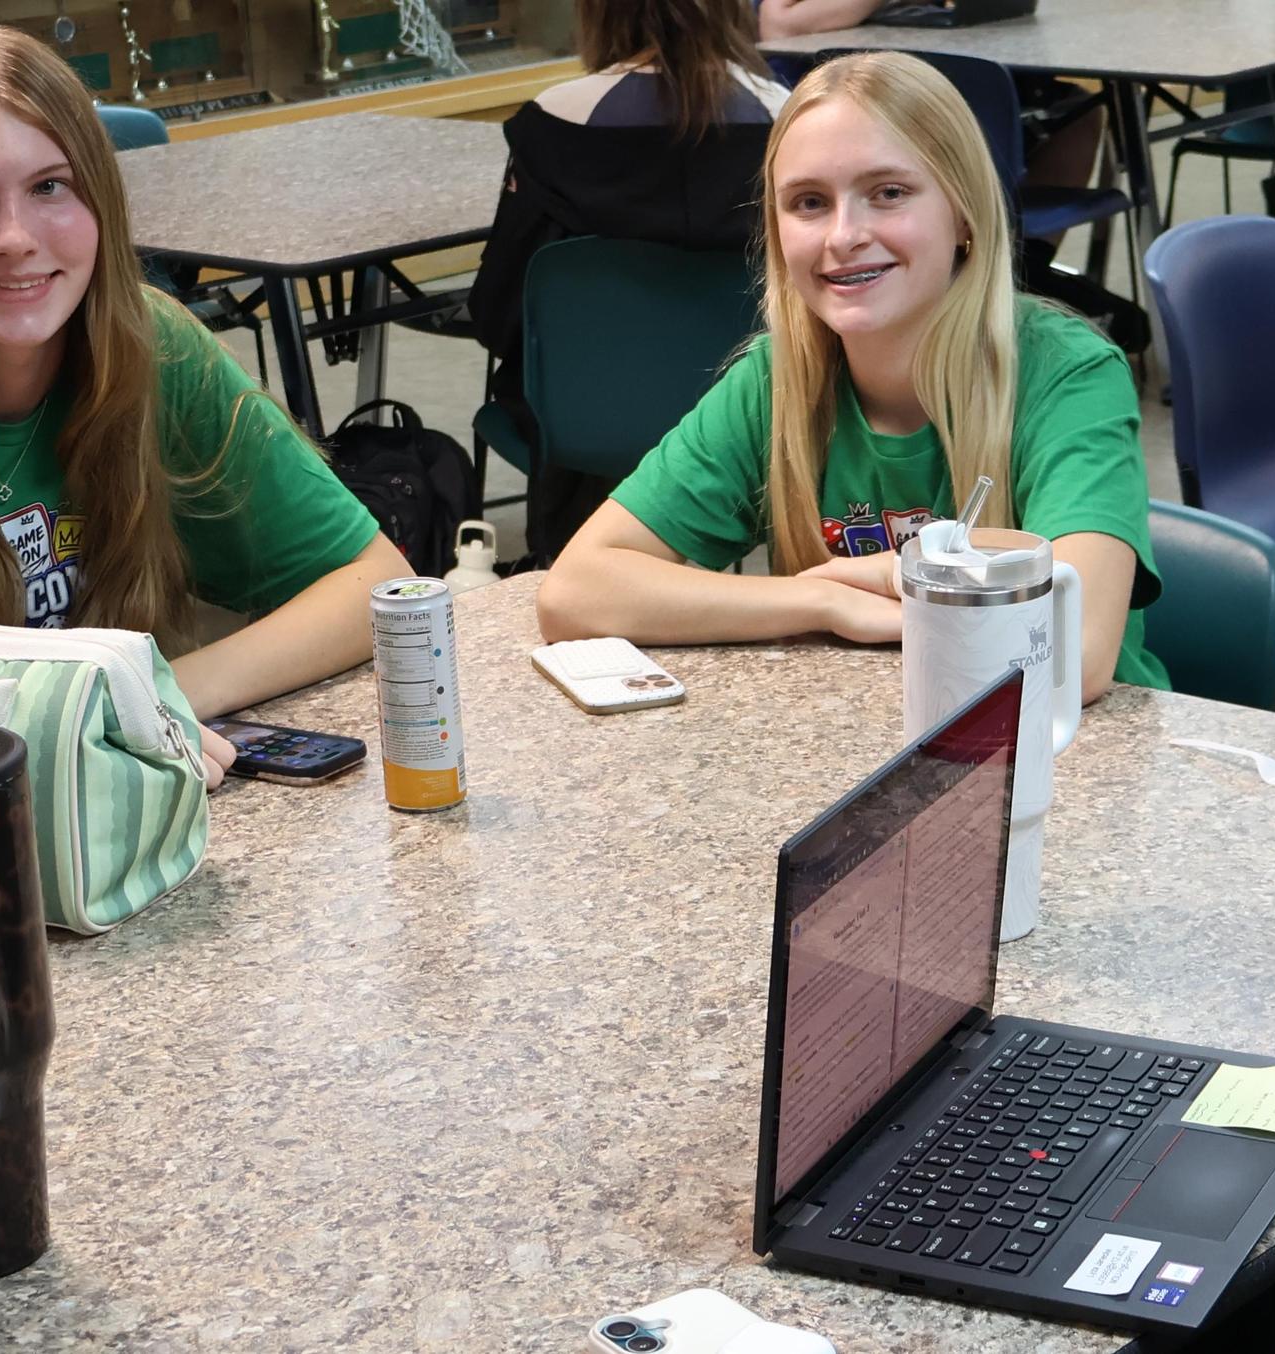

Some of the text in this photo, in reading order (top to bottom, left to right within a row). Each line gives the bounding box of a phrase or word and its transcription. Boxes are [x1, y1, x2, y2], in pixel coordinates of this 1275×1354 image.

[21, 544, 41, 566] ON
[408, 612, 430, 621] Facts
[1009, 646, 1053, 670] STANLE
